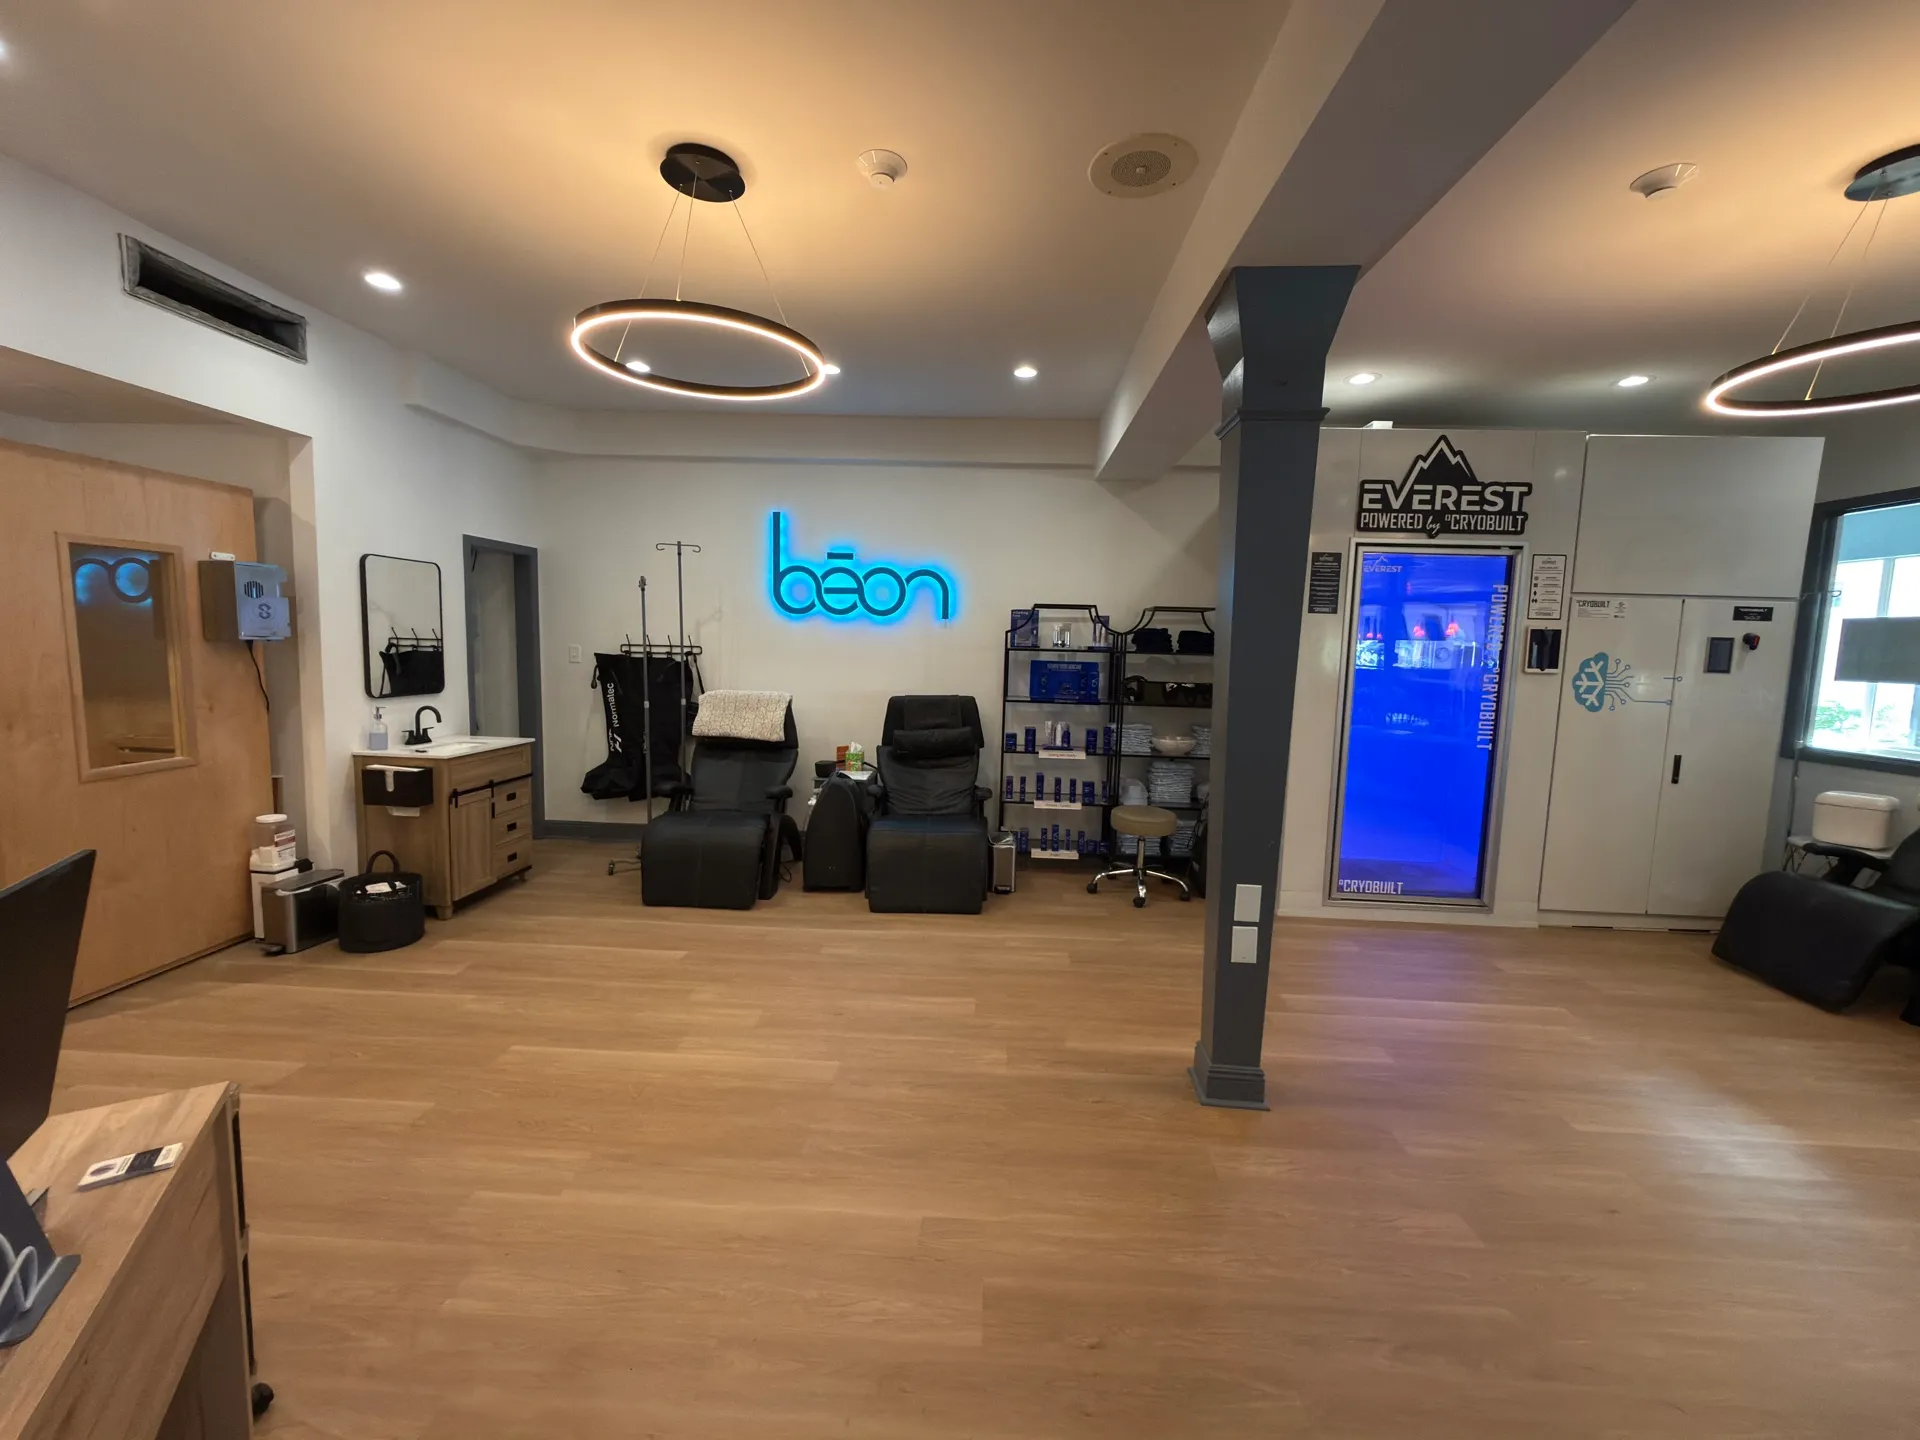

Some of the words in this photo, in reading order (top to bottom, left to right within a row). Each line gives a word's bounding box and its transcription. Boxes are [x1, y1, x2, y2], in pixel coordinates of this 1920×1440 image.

[1362, 483, 1529, 512] EVEREST
[1360, 512, 1423, 530] POWERED
[1425, 516, 1441, 534] by
[1363, 565, 1403, 573] EVEREST
[1486, 584, 1509, 651] POWERED
[606, 682, 620, 728] Normatec
